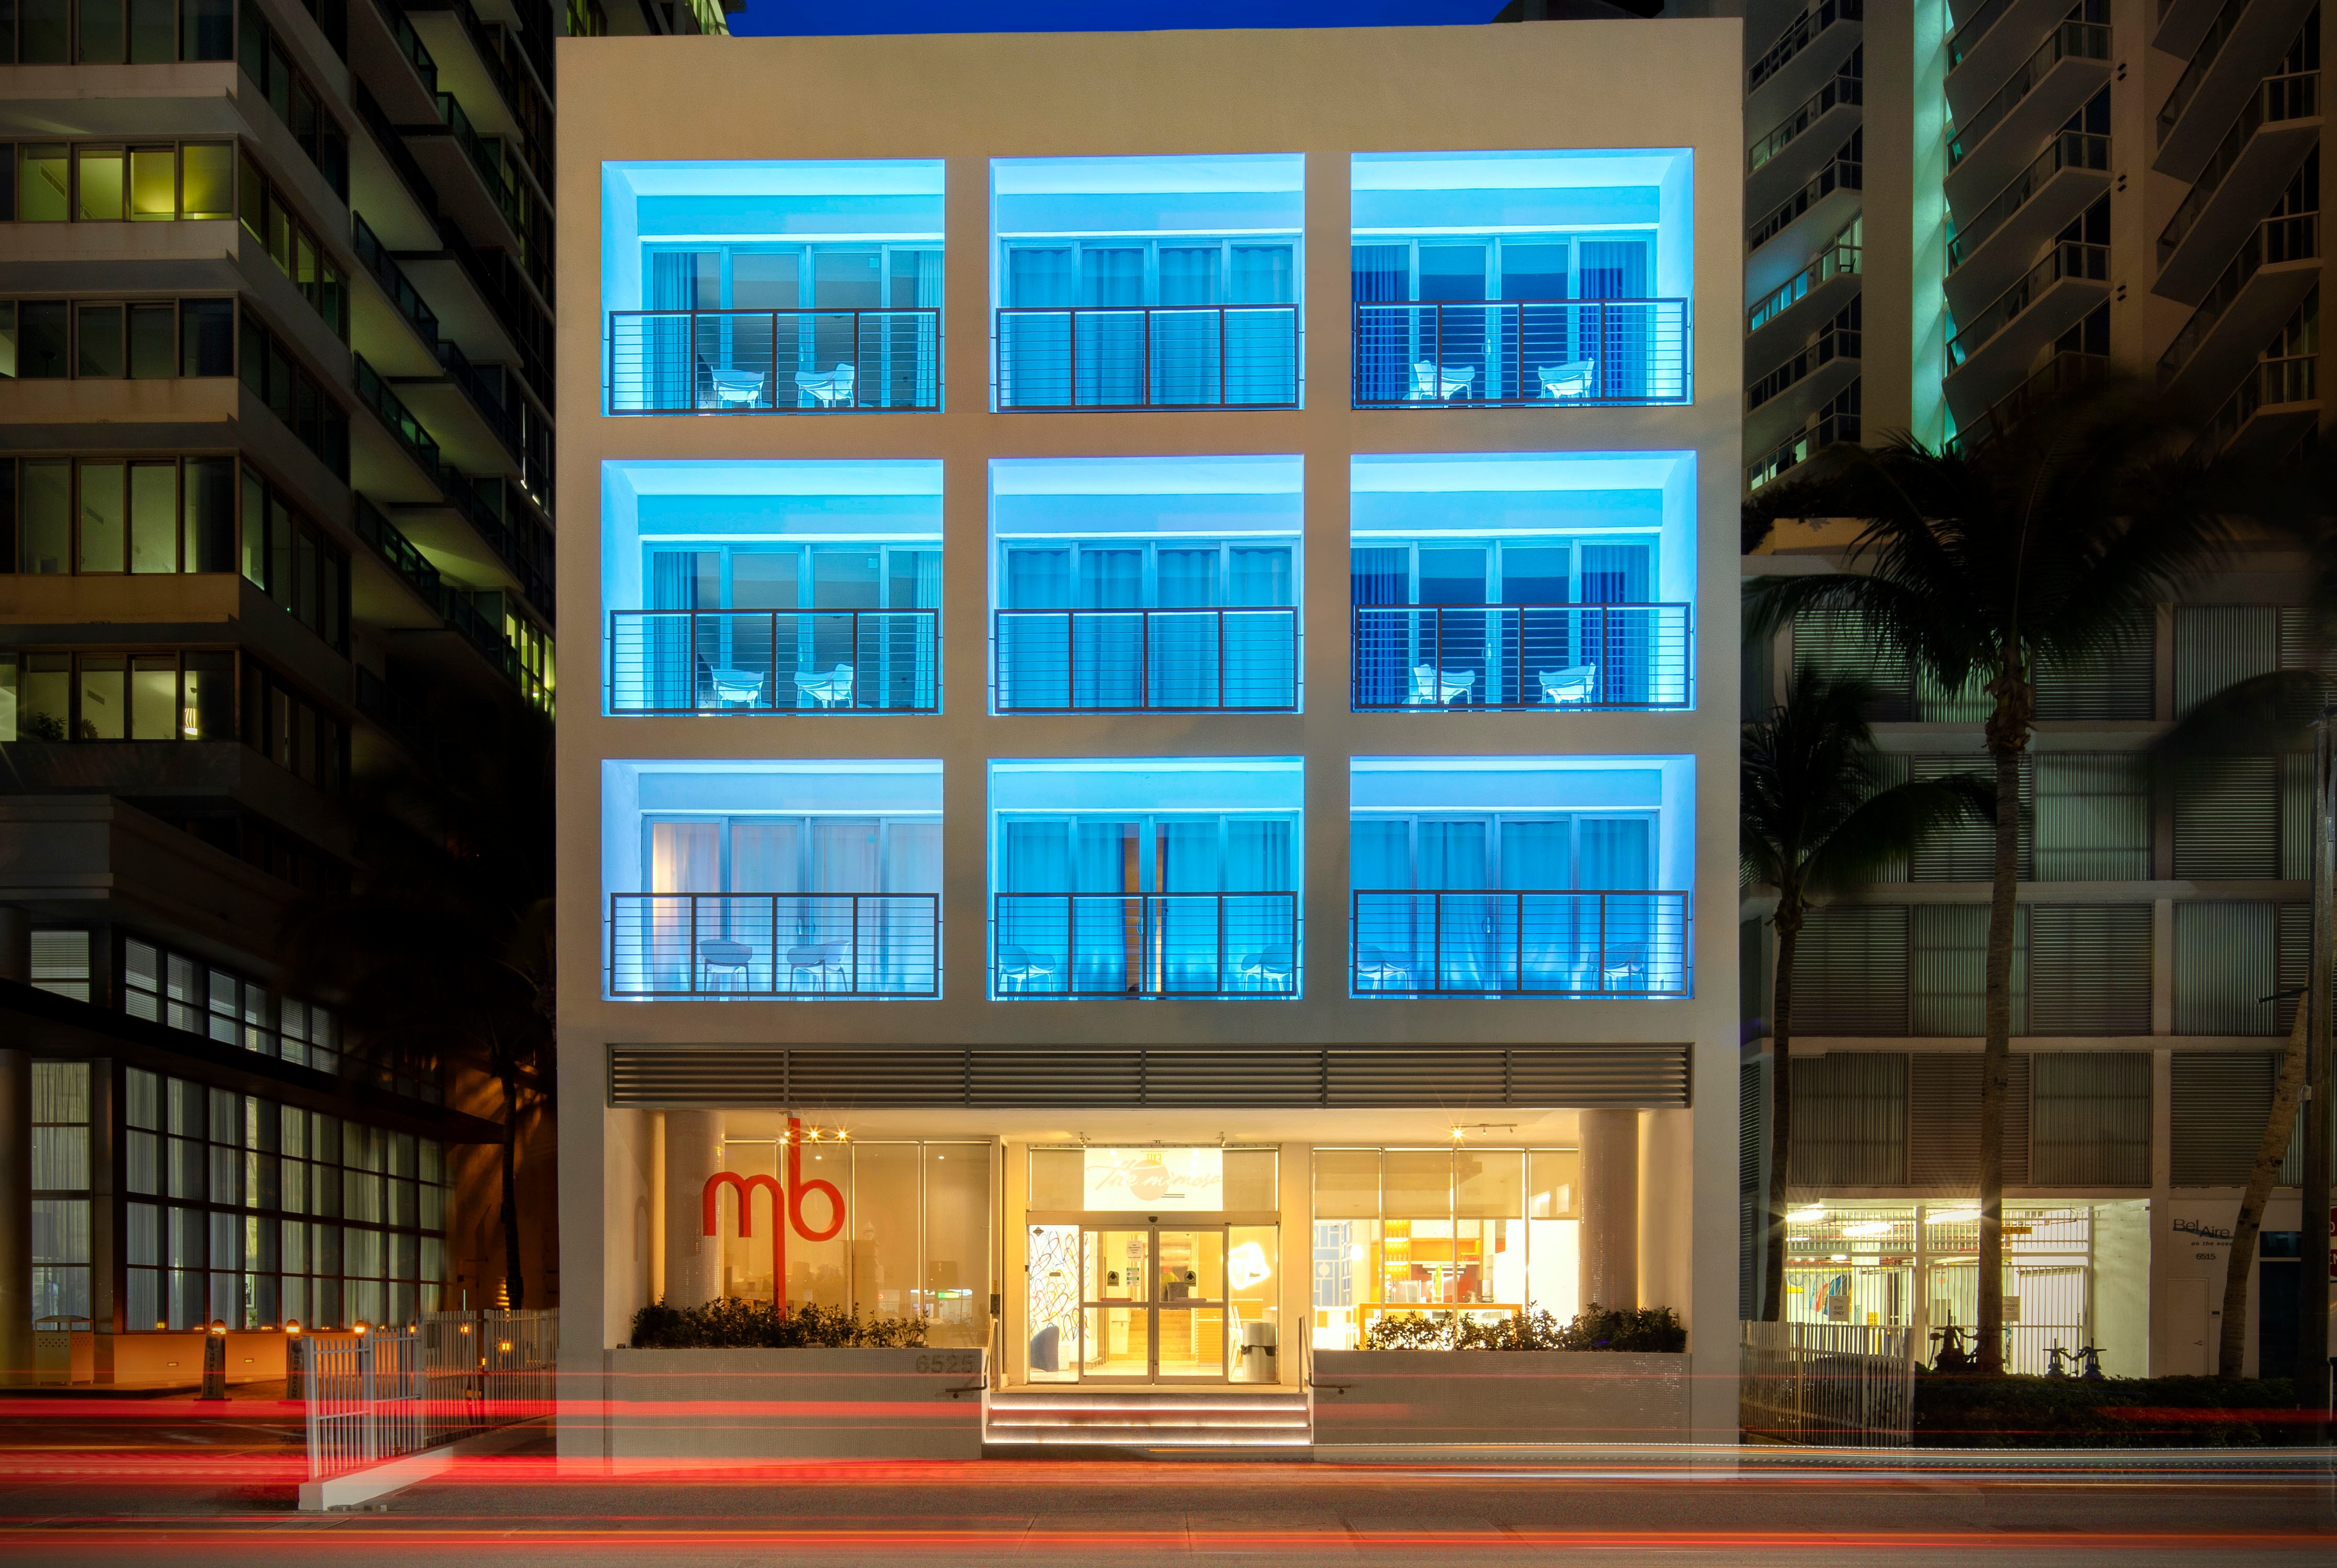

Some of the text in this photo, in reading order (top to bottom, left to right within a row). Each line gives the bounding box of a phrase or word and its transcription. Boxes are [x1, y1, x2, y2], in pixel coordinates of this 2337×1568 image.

[703, 1118, 845, 1322] mb
[2173, 1219, 2230, 1238] Bel Aire
[209, 1352, 215, 1361] NO
[294, 1355, 299, 1364] NO
[917, 1354, 973, 1373] 6525
